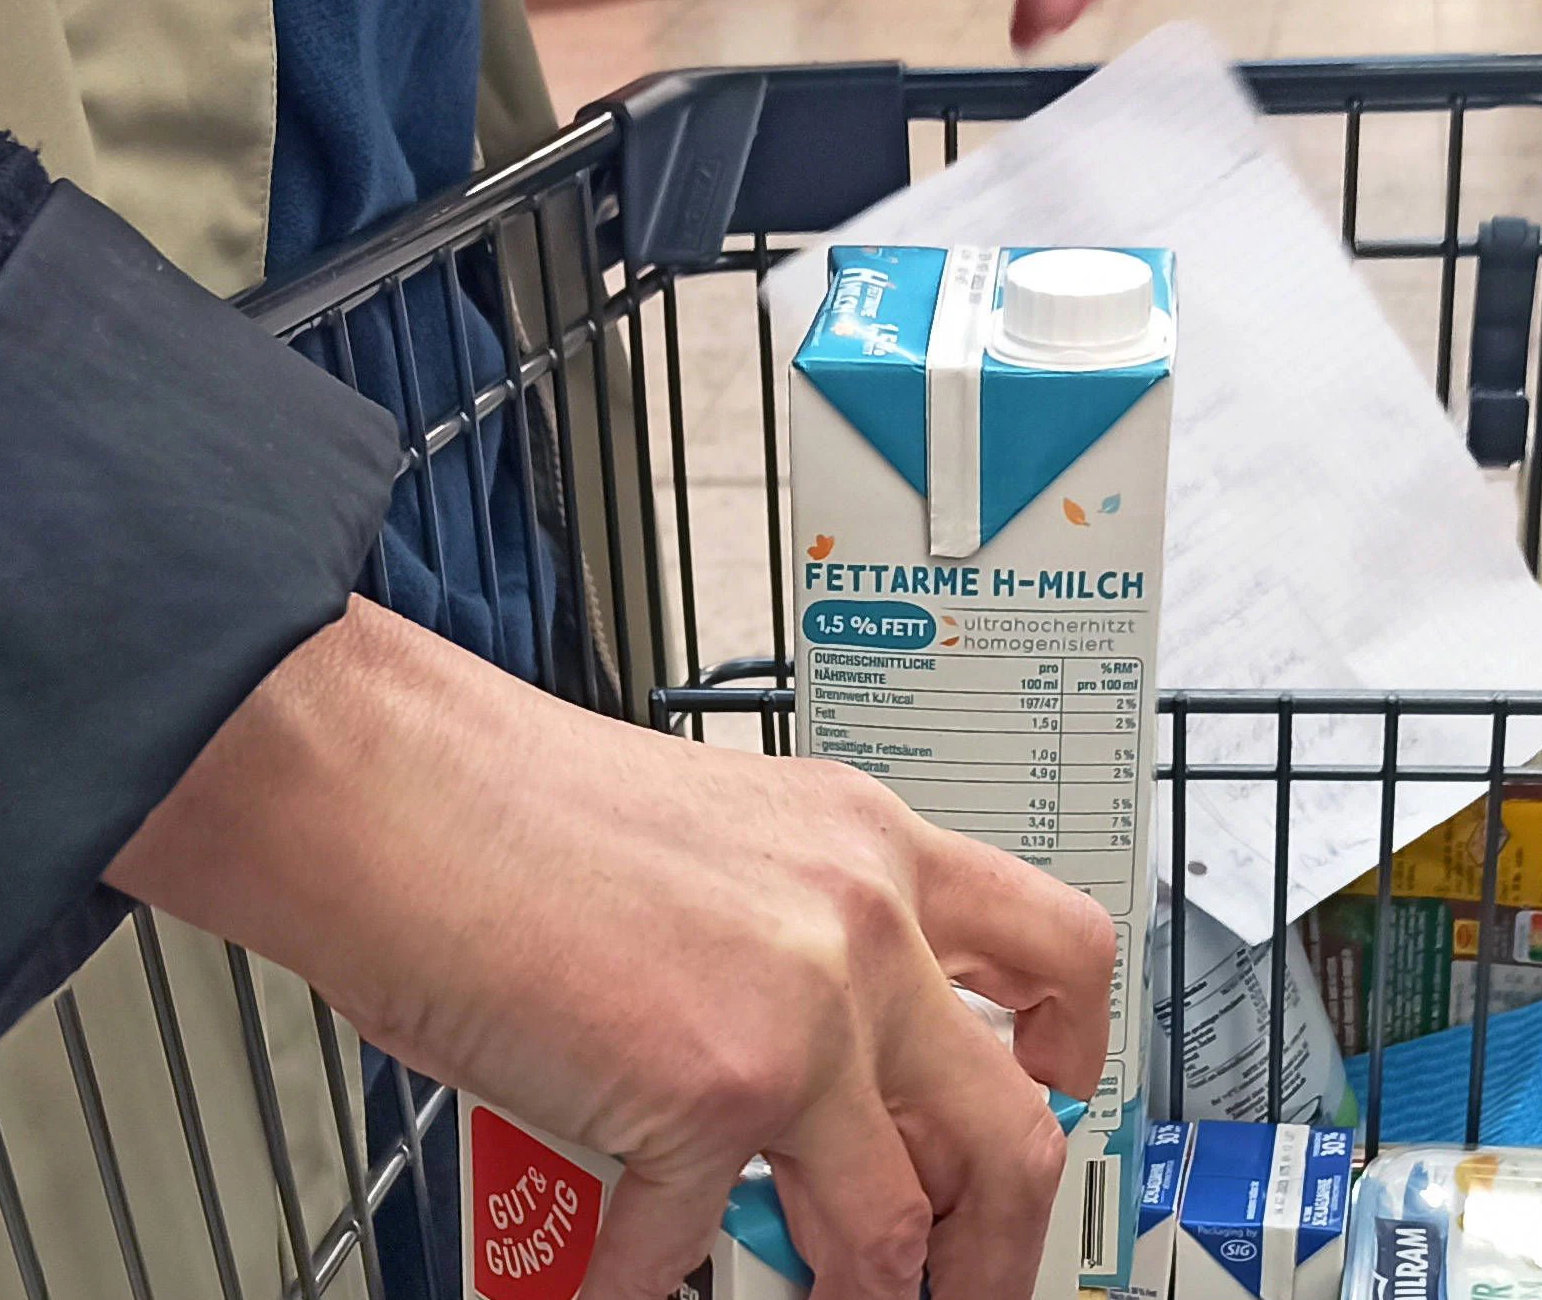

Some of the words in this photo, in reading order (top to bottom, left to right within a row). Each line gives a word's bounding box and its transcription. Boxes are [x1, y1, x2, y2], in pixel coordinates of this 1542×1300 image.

[805, 563, 980, 596] FETTARME
[993, 569, 1144, 599] H-MILCH
[816, 615, 844, 634] 1,5
[881, 619, 928, 637] FETT
[964, 617, 1135, 633] ultrahocherhitzt
[964, 636, 1114, 653] homogenisiert
[814, 653, 936, 671] DURCHSCHNITTLICHE
[814, 669, 886, 685] NÄHRWERTE
[1038, 665, 1059, 676] pro
[1020, 678, 1047, 690] 100
[1077, 681, 1096, 693] pro
[1100, 680, 1121, 691] 100
[815, 689, 868, 703] Brennwert
[1020, 697, 1059, 711] 197/47
[815, 708, 836, 720] Fett
[875, 743, 932, 758] Fettsäuren
[485, 1179, 579, 1279] GÜNSTIG
[1197, 1226, 1245, 1240] Packaging
[1226, 1243, 1252, 1256] SIG
